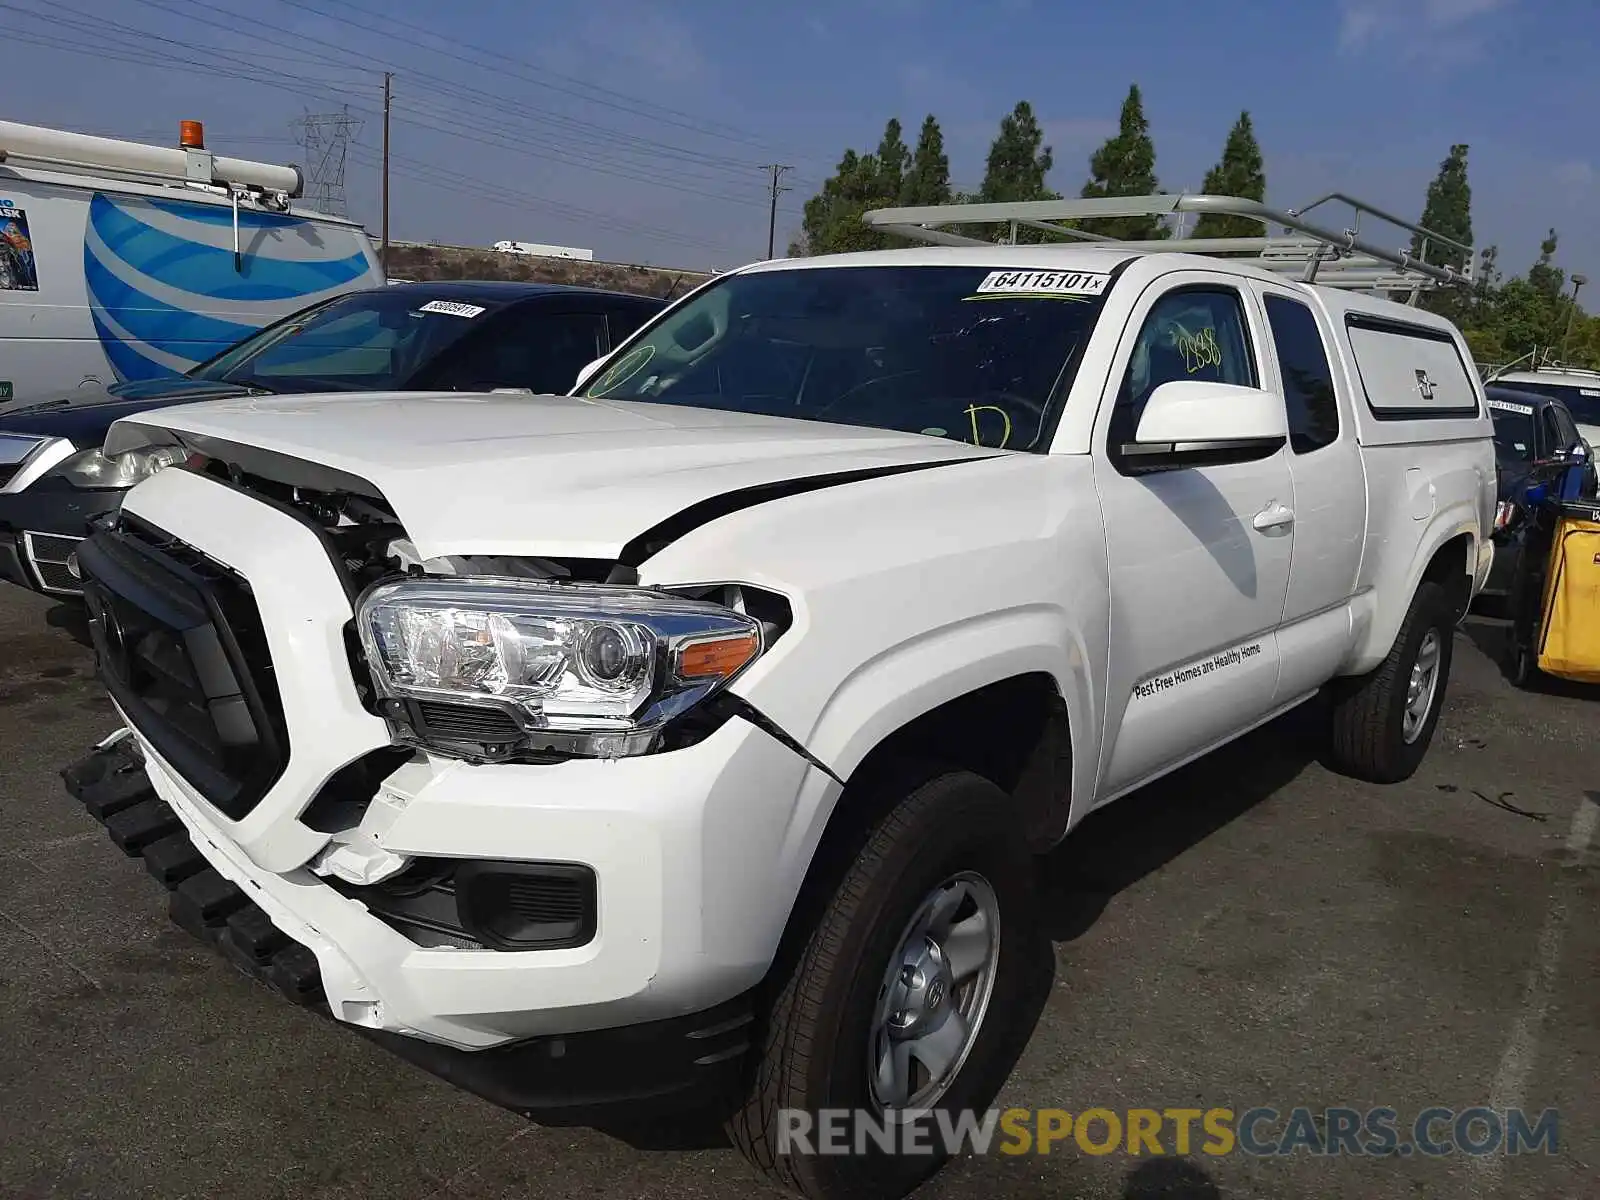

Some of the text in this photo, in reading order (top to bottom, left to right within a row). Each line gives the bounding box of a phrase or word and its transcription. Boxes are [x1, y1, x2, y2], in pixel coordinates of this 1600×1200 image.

[963, 404, 1010, 449] D
[1155, 676, 1174, 692] Free
[1173, 665, 1202, 685] Homes
[1202, 661, 1215, 675] are
[1213, 650, 1241, 669] Healthy
